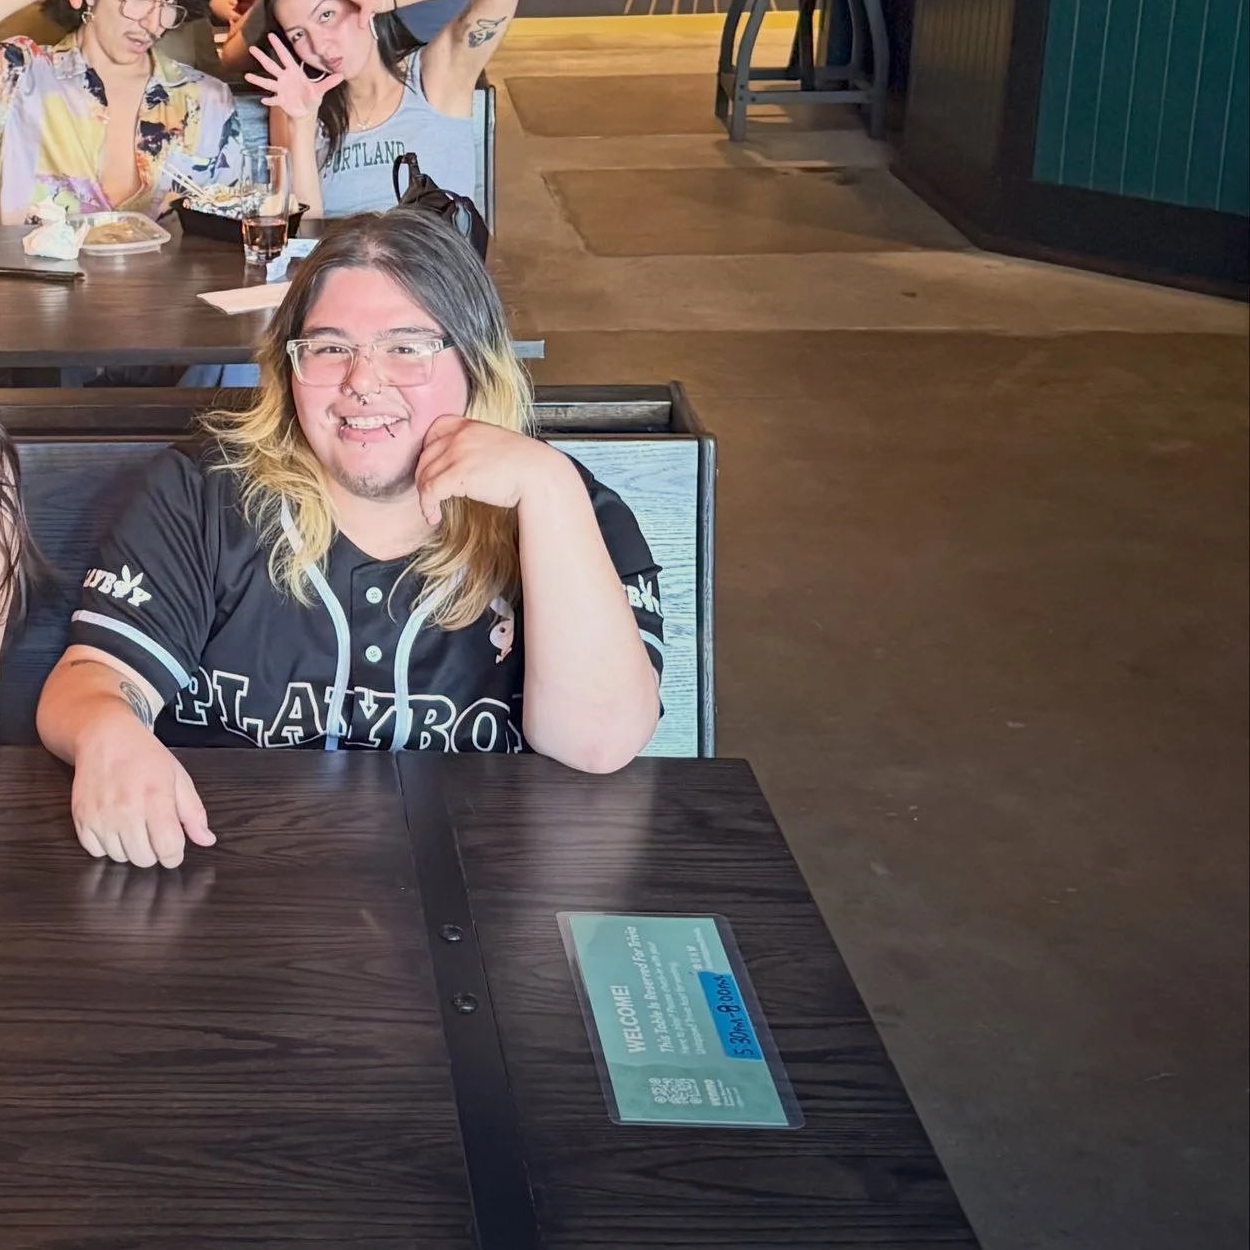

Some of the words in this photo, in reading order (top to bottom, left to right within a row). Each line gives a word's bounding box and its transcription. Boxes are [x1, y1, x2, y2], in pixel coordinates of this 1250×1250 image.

[175, 666, 523, 754] PLAYBO
[624, 926, 642, 948] Trivia
[632, 947, 647, 962] For
[634, 961, 658, 1000] Reserved
[646, 1001, 661, 1010] Is
[610, 985, 647, 1053] WELCOME!
[649, 1009, 669, 1034] Table
[656, 1034, 675, 1053] This
